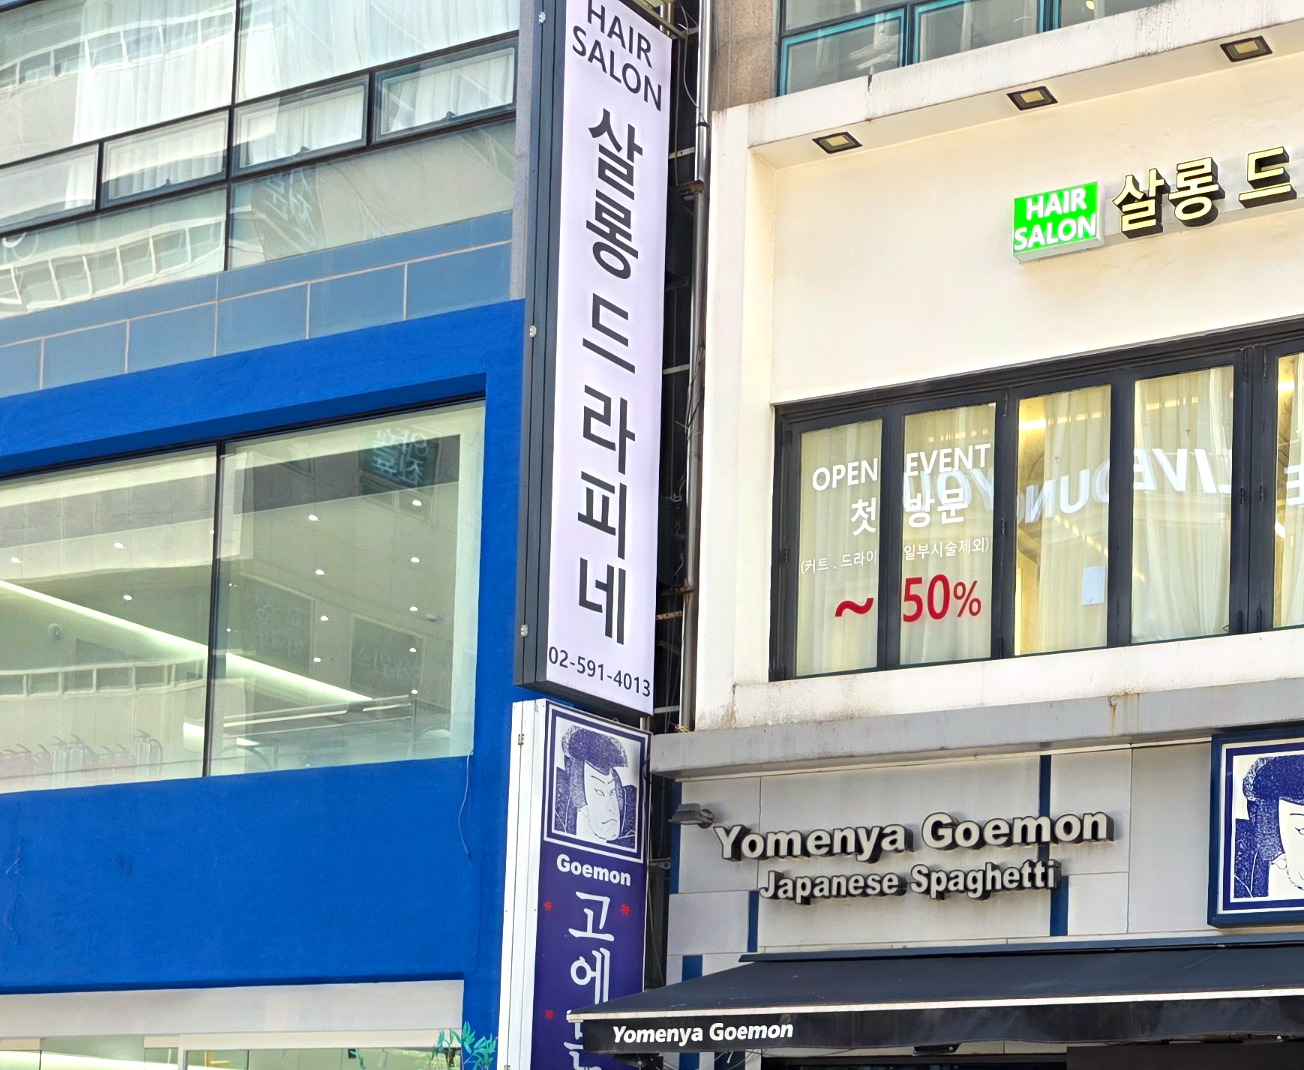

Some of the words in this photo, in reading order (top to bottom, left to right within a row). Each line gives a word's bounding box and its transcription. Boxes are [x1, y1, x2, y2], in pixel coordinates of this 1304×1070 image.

[587, 0, 652, 68] HAIR
[572, 41, 663, 111] SALON
[1026, 188, 1087, 221] HAIR
[1014, 213, 1096, 251] SALON
[812, 458, 878, 491] OPEN
[906, 443, 991, 477] EVENT
[851, 497, 877, 536] 첫
[905, 488, 968, 528] 방문
[841, 549, 878, 568] 드라이
[903, 574, 982, 622] 50%
[548, 645, 652, 698] 02-591-4013
[713, 822, 912, 864] Yomenya
[921, 811, 1113, 850] Goemon
[557, 854, 631, 887] Goemon
[760, 871, 903, 905] Japanese
[910, 859, 1061, 900] Spaghetti
[613, 1025, 703, 1046] Yomenya
[709, 1023, 793, 1041] Goemon
